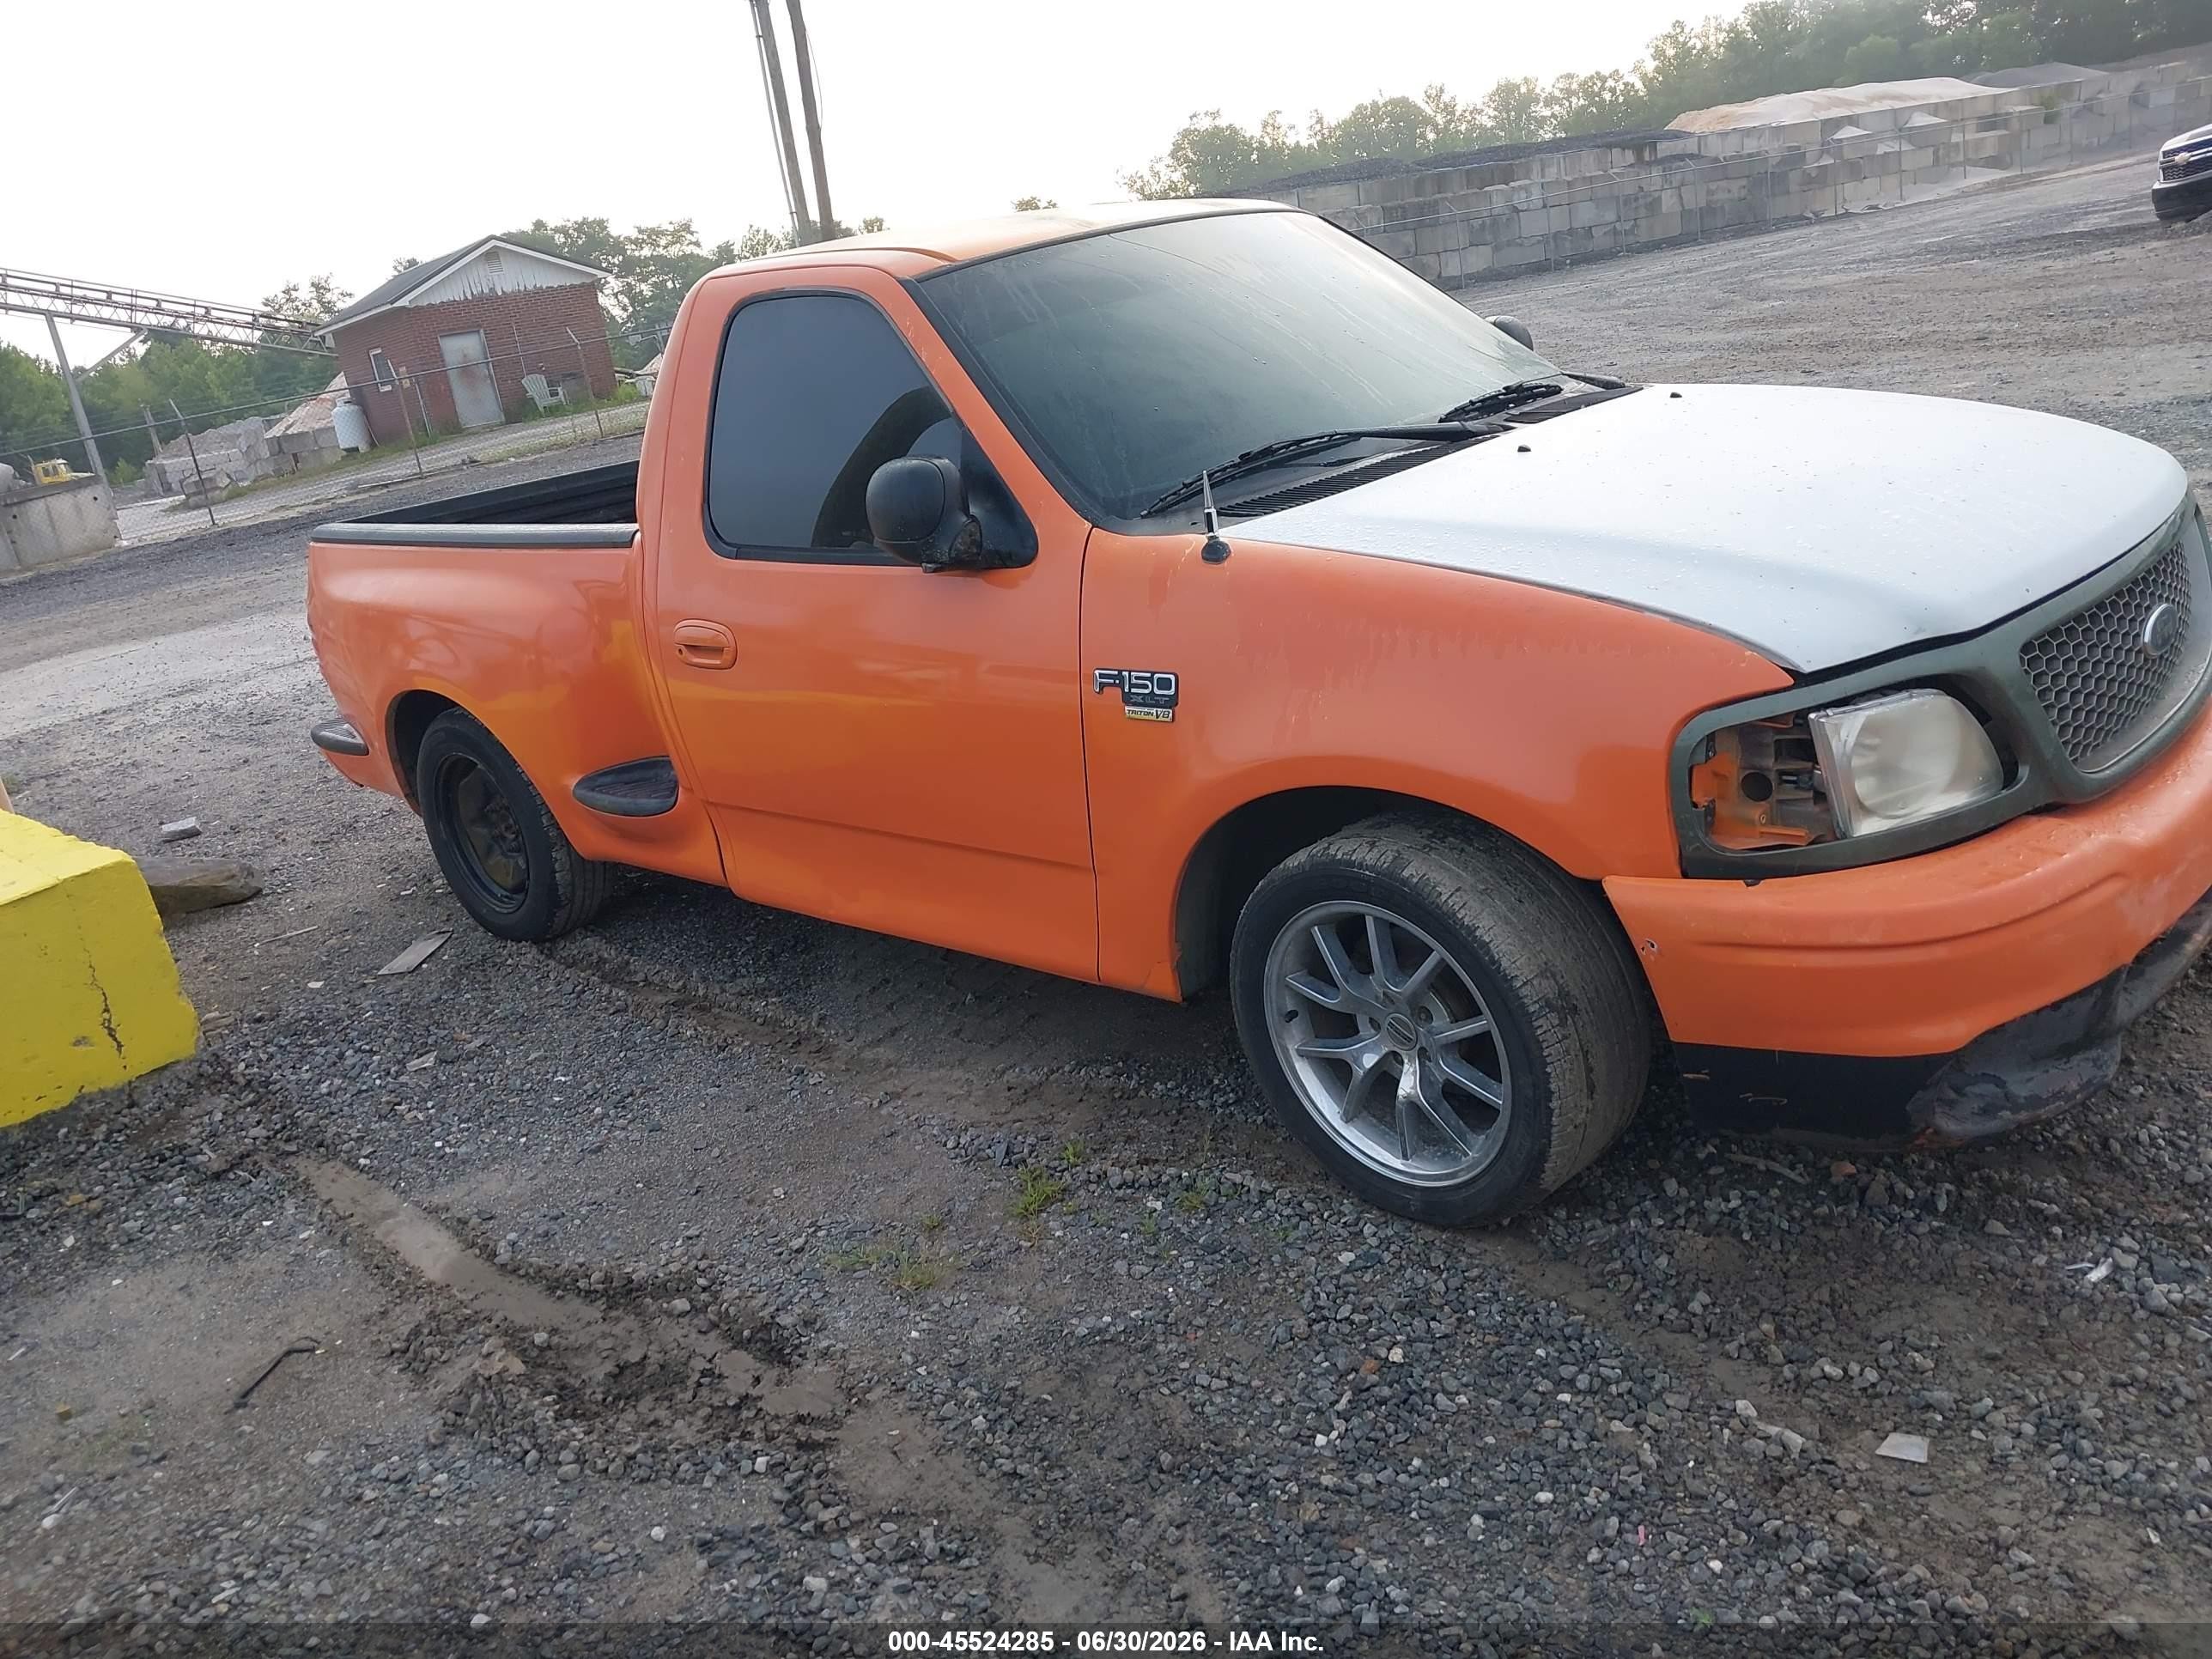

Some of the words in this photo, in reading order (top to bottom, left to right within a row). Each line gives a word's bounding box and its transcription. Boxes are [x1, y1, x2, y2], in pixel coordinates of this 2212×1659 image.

[1093, 669, 1176, 695] F-150
[1126, 708, 1155, 717] TRITON
[1155, 708, 1171, 719] V8
